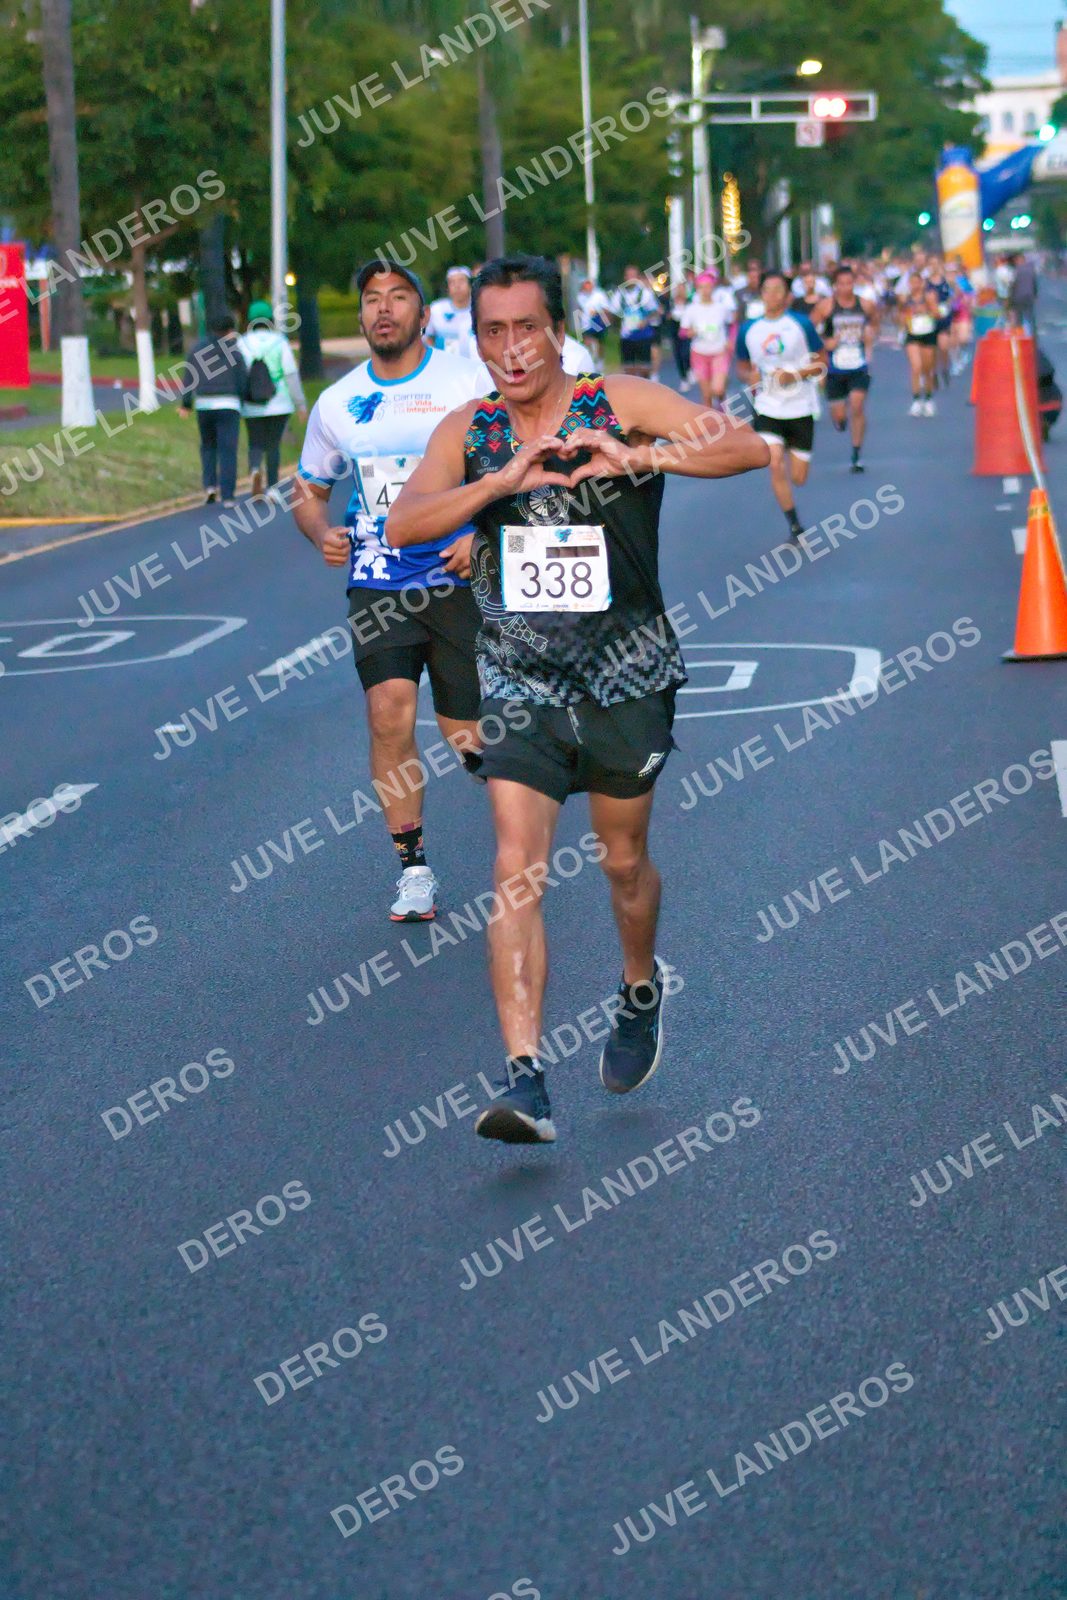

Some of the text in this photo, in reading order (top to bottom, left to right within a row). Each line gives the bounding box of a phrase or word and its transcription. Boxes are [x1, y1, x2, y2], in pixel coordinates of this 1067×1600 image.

[393, 393, 431, 402] Carrera
[376, 482, 404, 509] 4
[520, 561, 593, 598] 338
